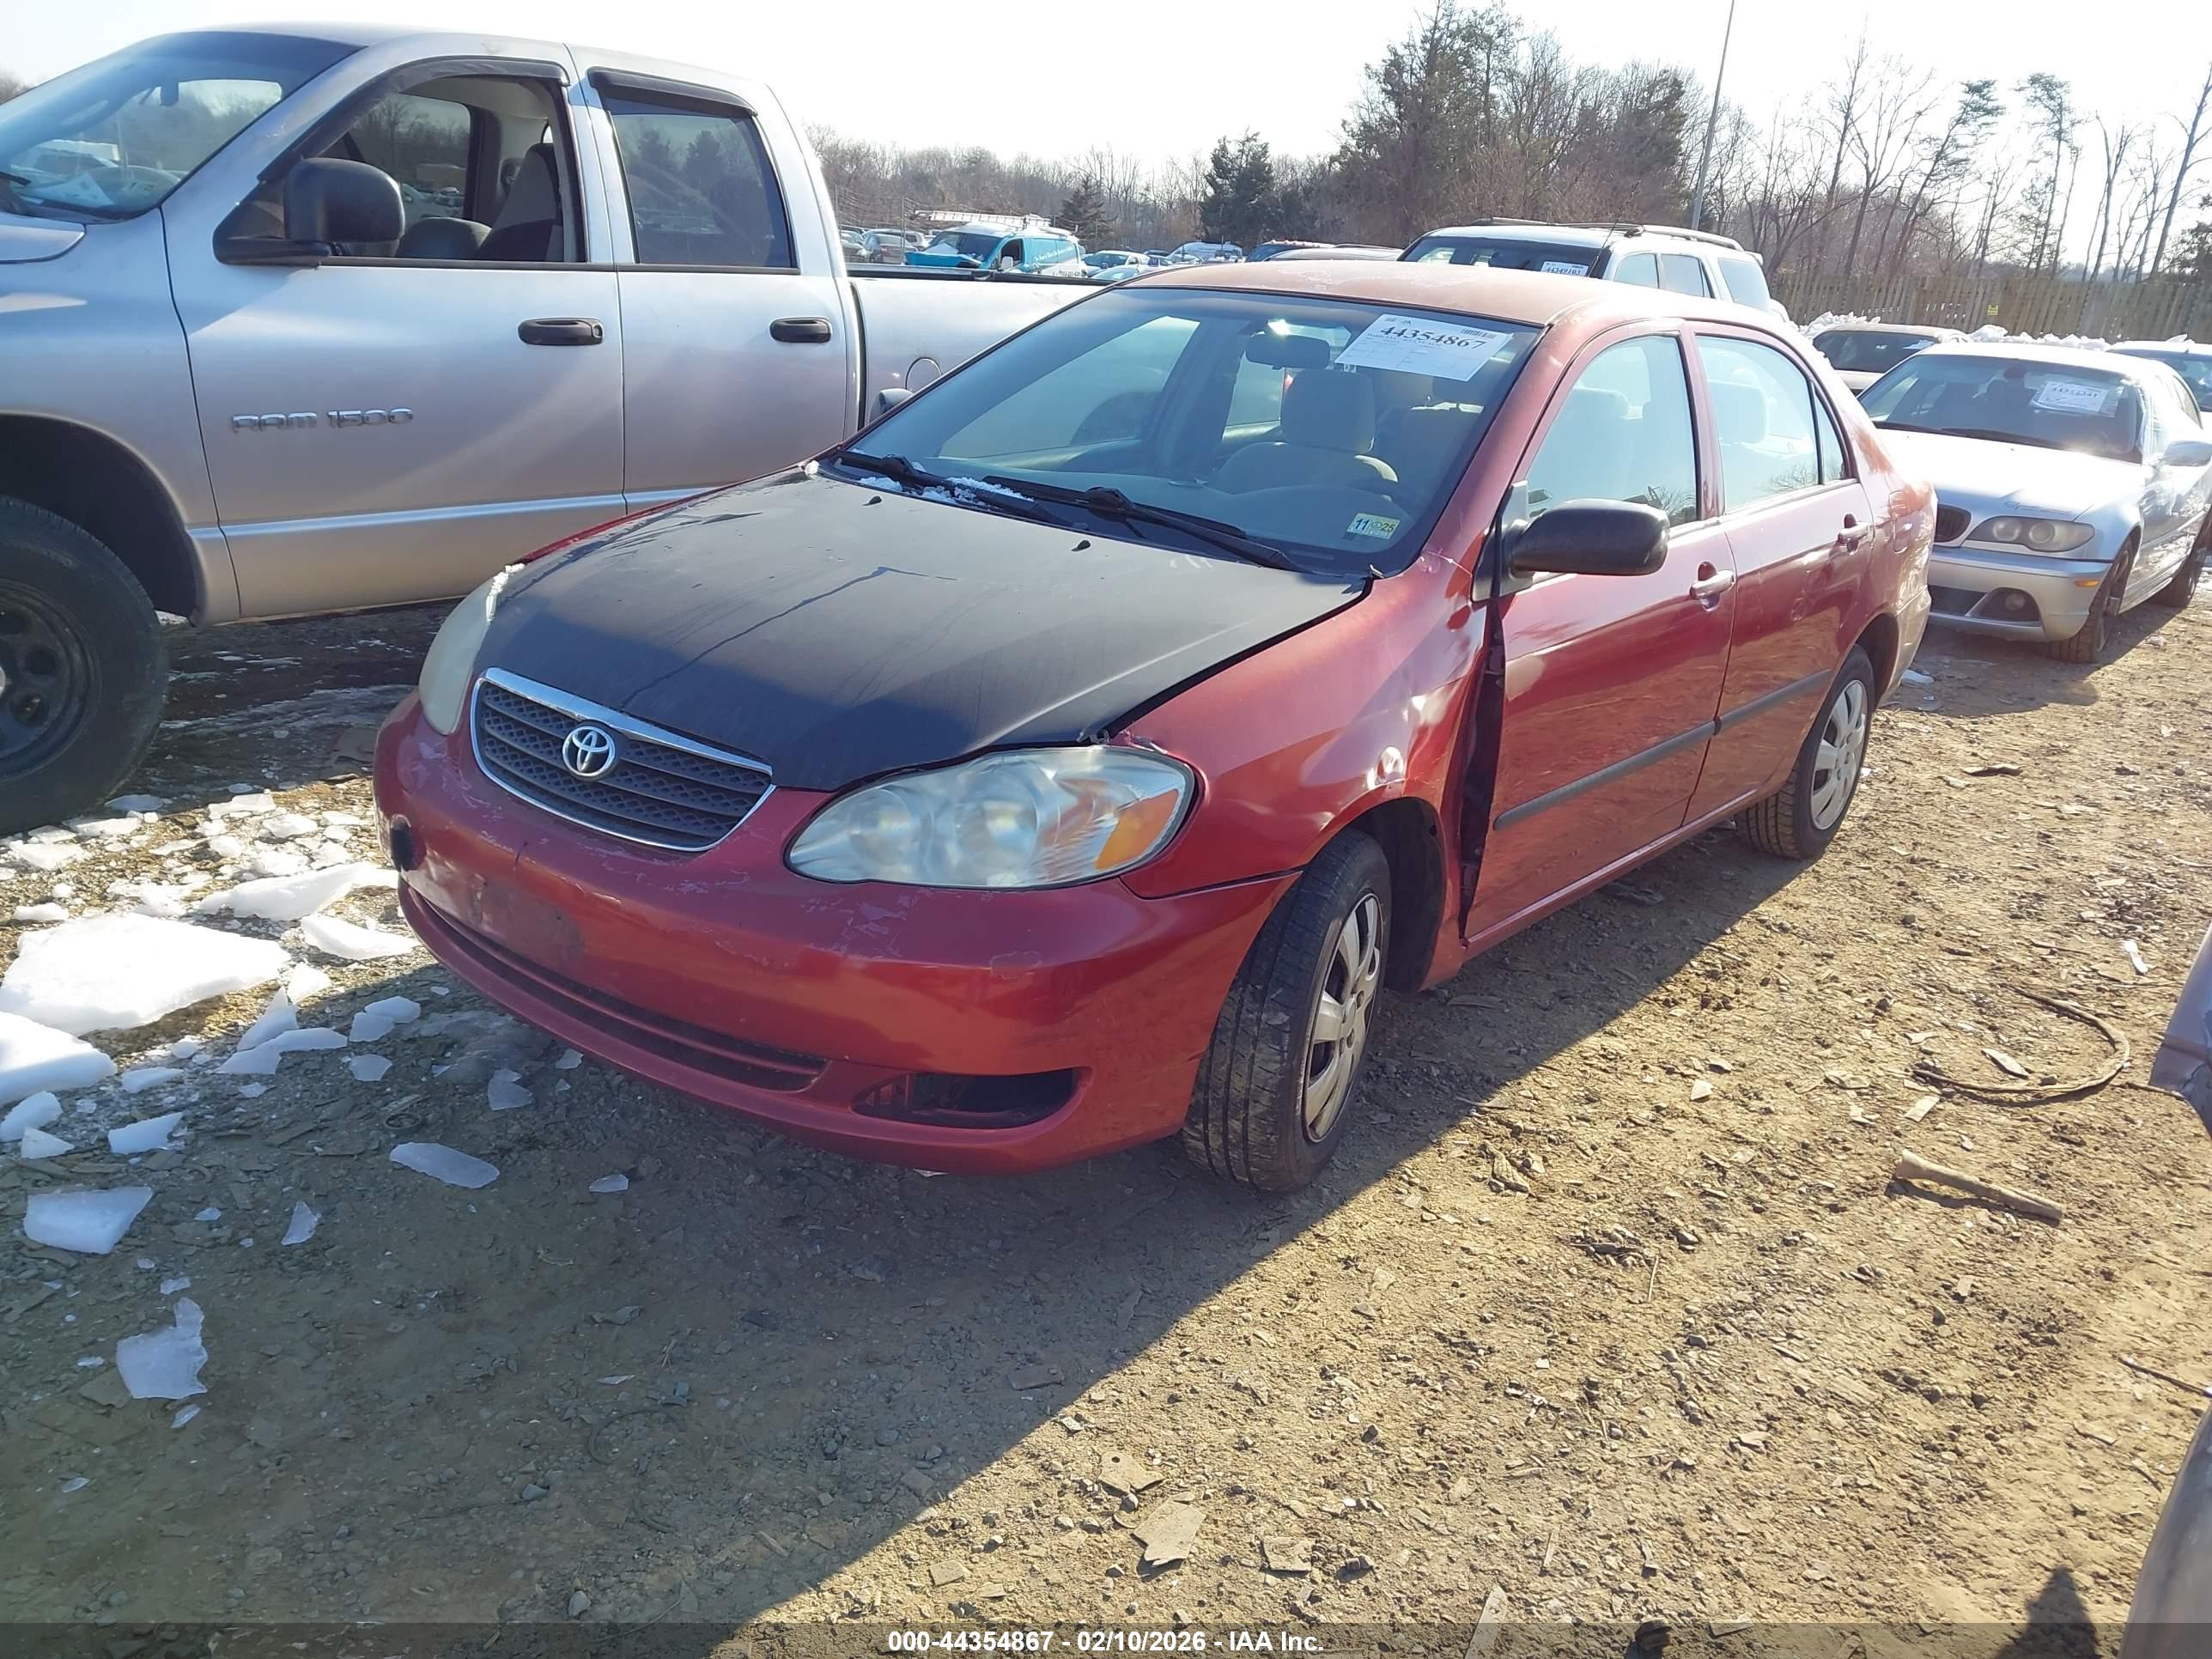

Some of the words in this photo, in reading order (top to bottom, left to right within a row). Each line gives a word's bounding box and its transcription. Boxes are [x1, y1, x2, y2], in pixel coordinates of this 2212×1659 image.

[1381, 325, 1487, 349] 44354867
[232, 412, 317, 433] RAM
[327, 407, 414, 428] 1500
[1356, 519, 1370, 531] 11
[1381, 522, 1395, 532] 25
